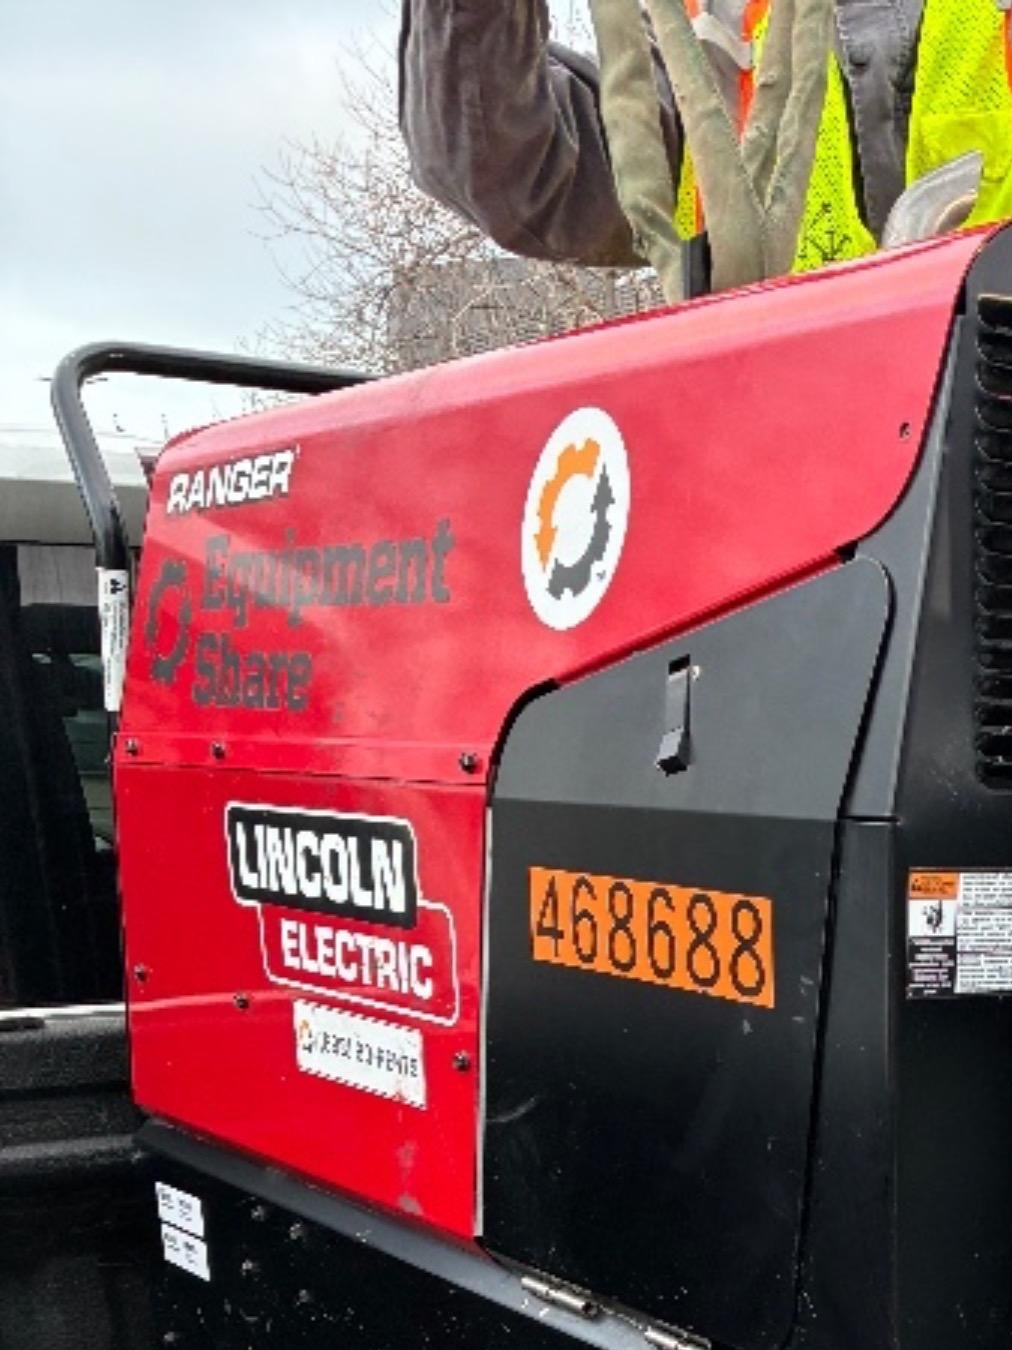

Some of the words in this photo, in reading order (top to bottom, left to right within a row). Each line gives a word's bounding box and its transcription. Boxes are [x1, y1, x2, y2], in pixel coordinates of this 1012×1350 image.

[166, 449, 295, 514] RANGER
[203, 517, 456, 629] Equipment
[193, 633, 312, 712] Share
[236, 821, 406, 913] LINCOLN
[280, 918, 433, 1000] ELECTRIC
[536, 875, 766, 997] 468688
